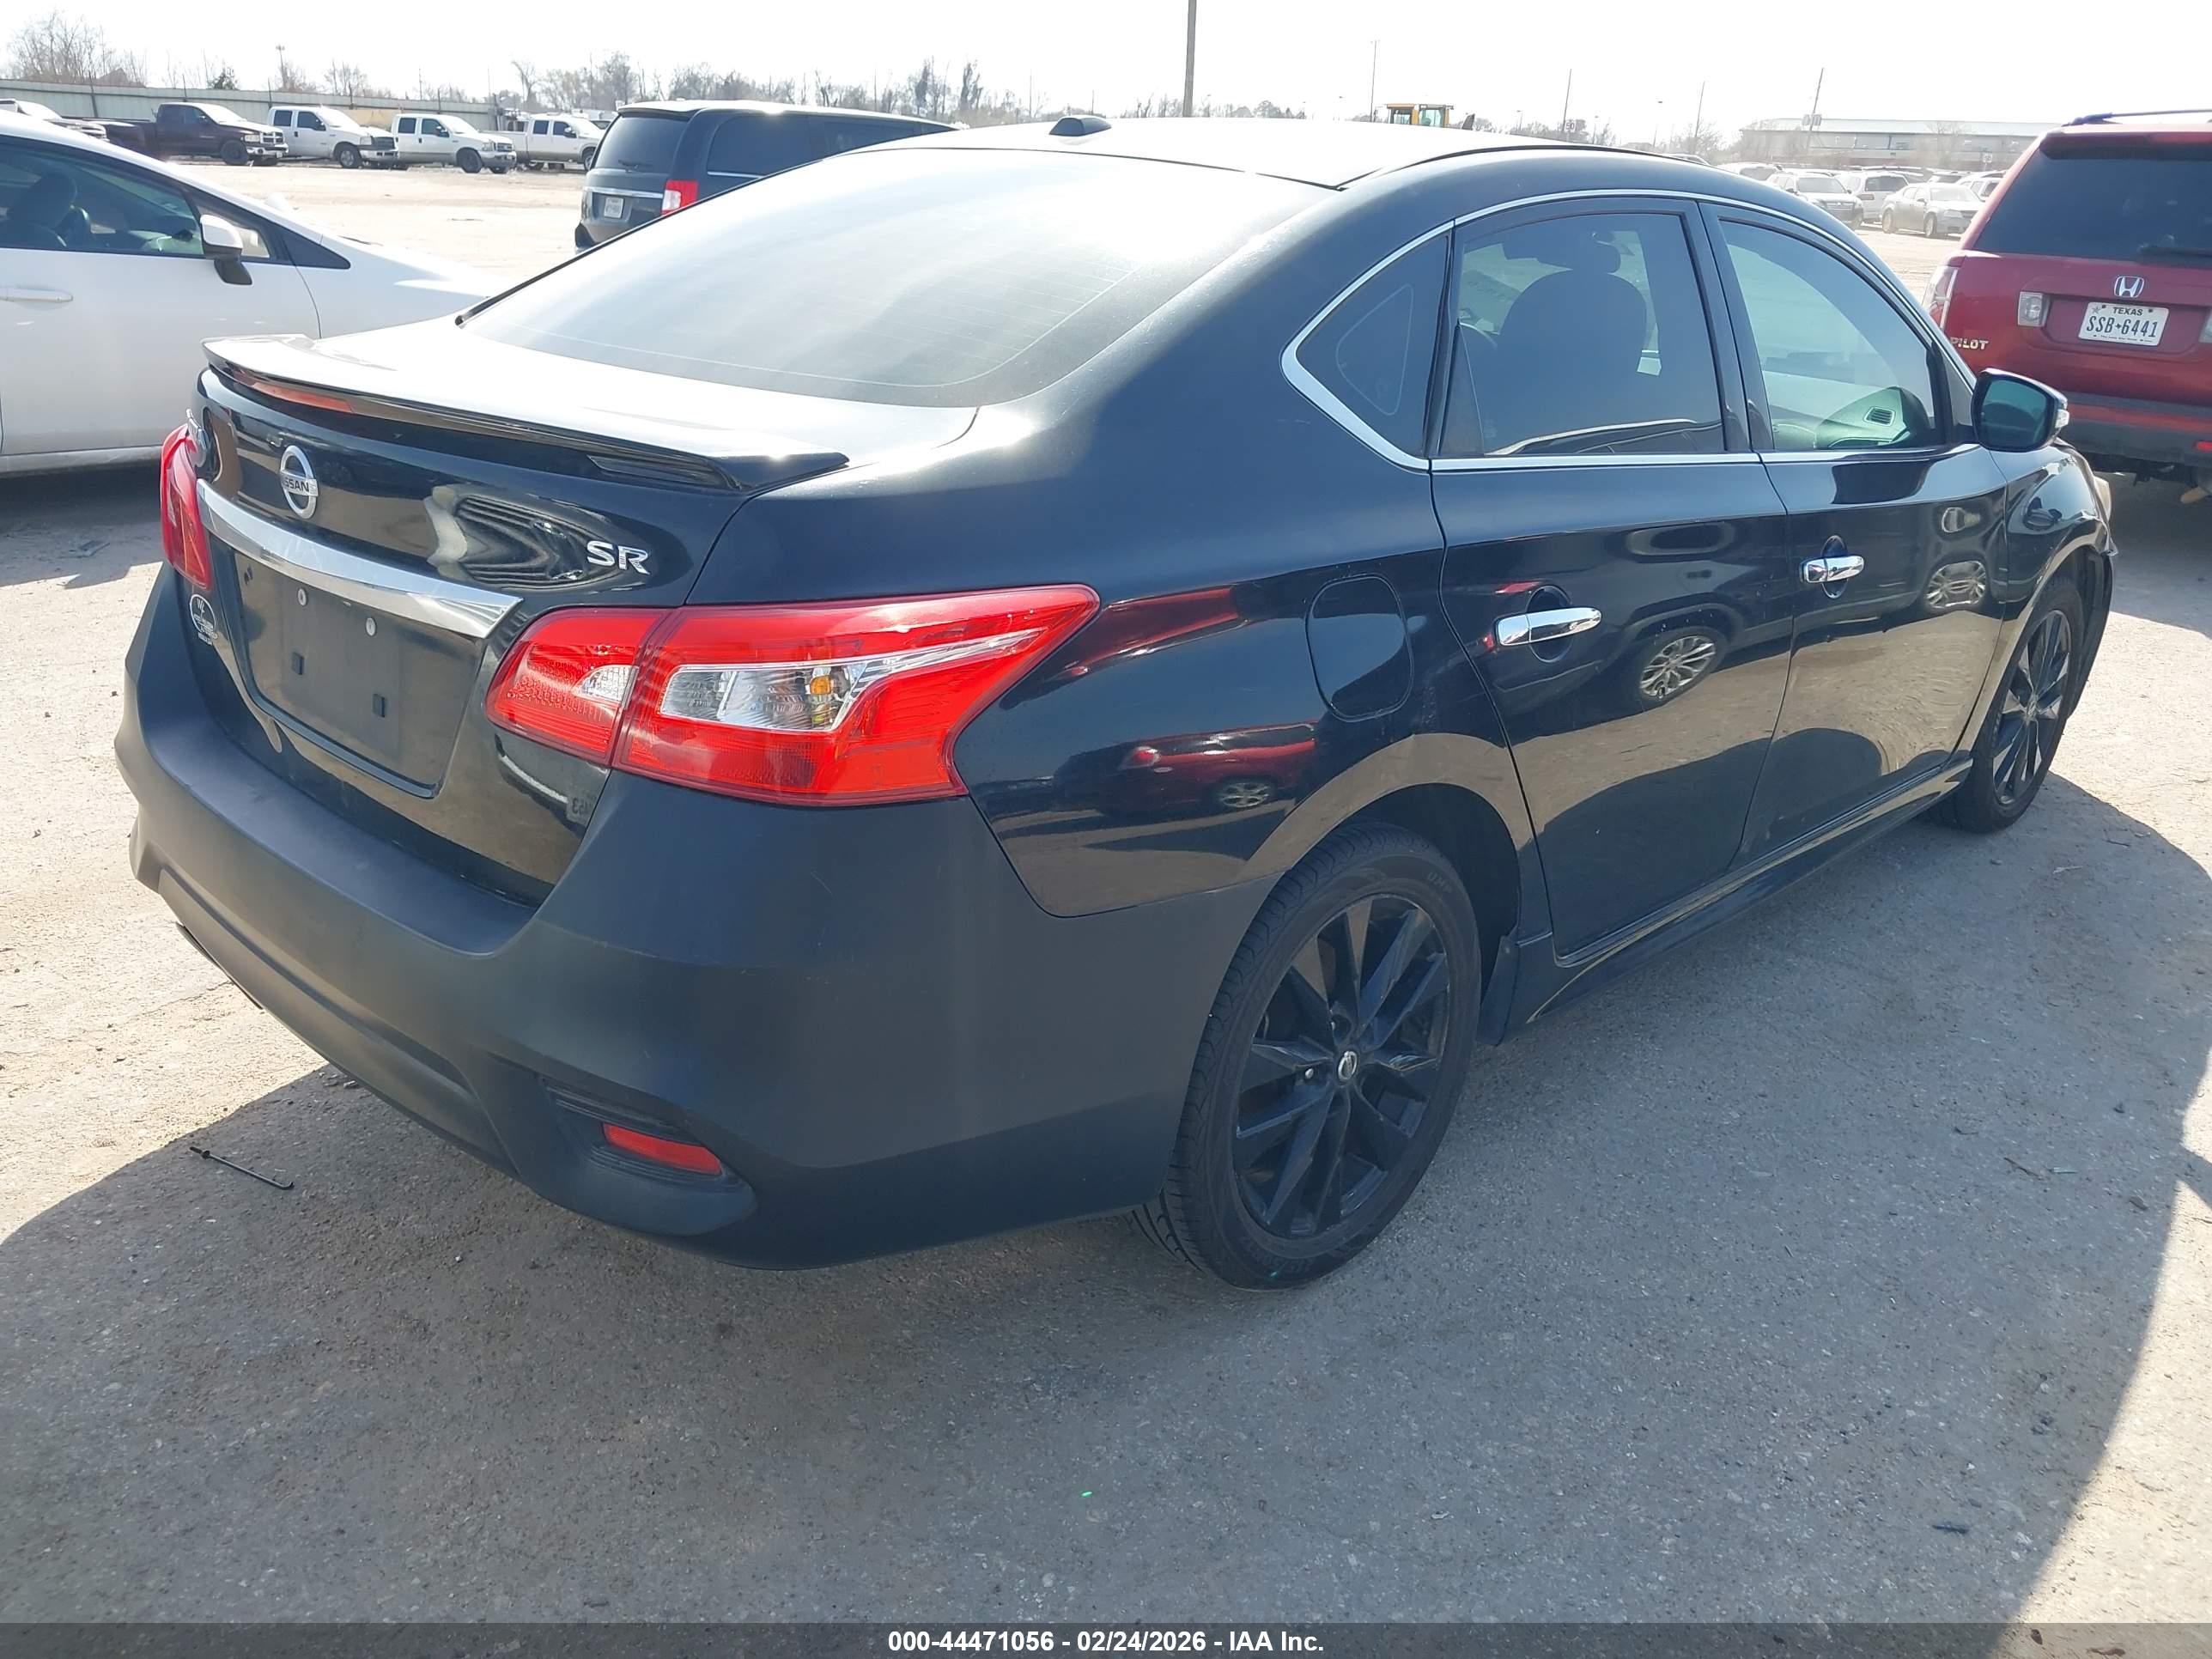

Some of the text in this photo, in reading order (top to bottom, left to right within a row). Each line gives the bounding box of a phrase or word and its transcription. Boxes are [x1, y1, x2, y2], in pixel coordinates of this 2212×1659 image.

[2112, 307, 2143, 316] TEXAS
[281, 474, 310, 493] SSAN
[586, 540, 651, 575] SR
